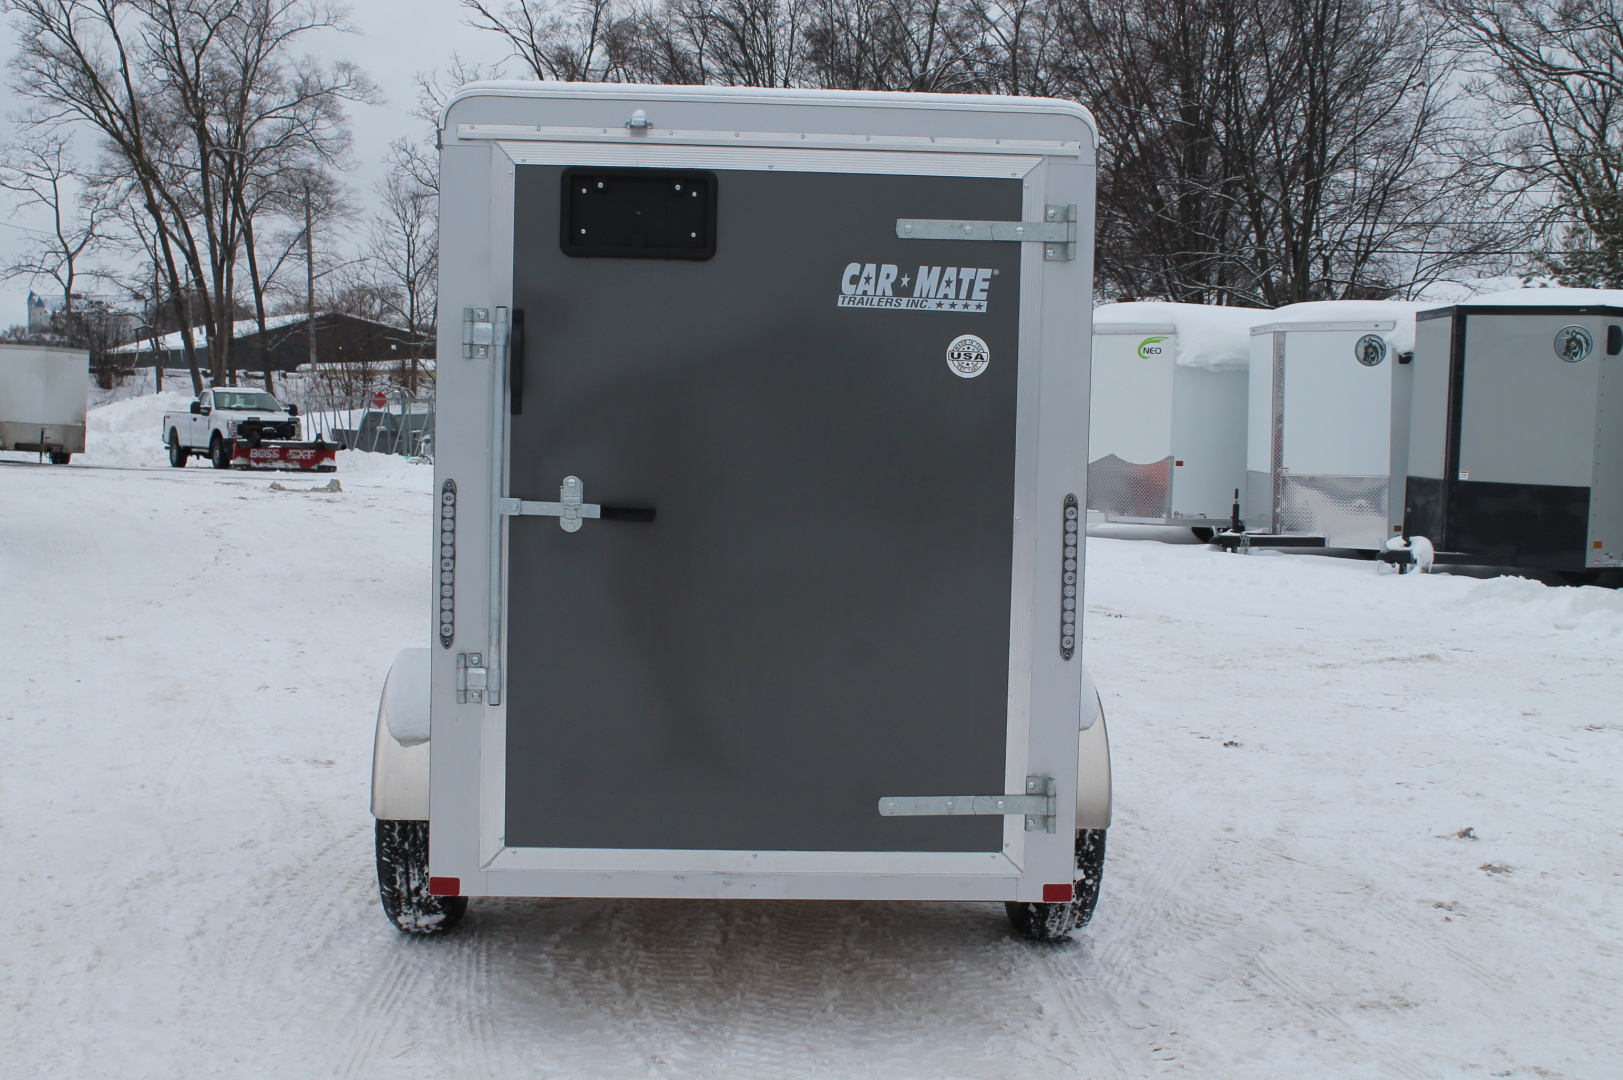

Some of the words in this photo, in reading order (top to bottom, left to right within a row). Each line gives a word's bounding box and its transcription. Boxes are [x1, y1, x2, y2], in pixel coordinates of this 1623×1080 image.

[841, 262, 898, 296] CAR
[912, 265, 993, 300] MATE
[840, 295, 902, 308] TRAILERS
[906, 298, 931, 309] INC.
[950, 352, 985, 361] USA
[1142, 347, 1162, 355] NEO
[250, 448, 280, 459] BOSS
